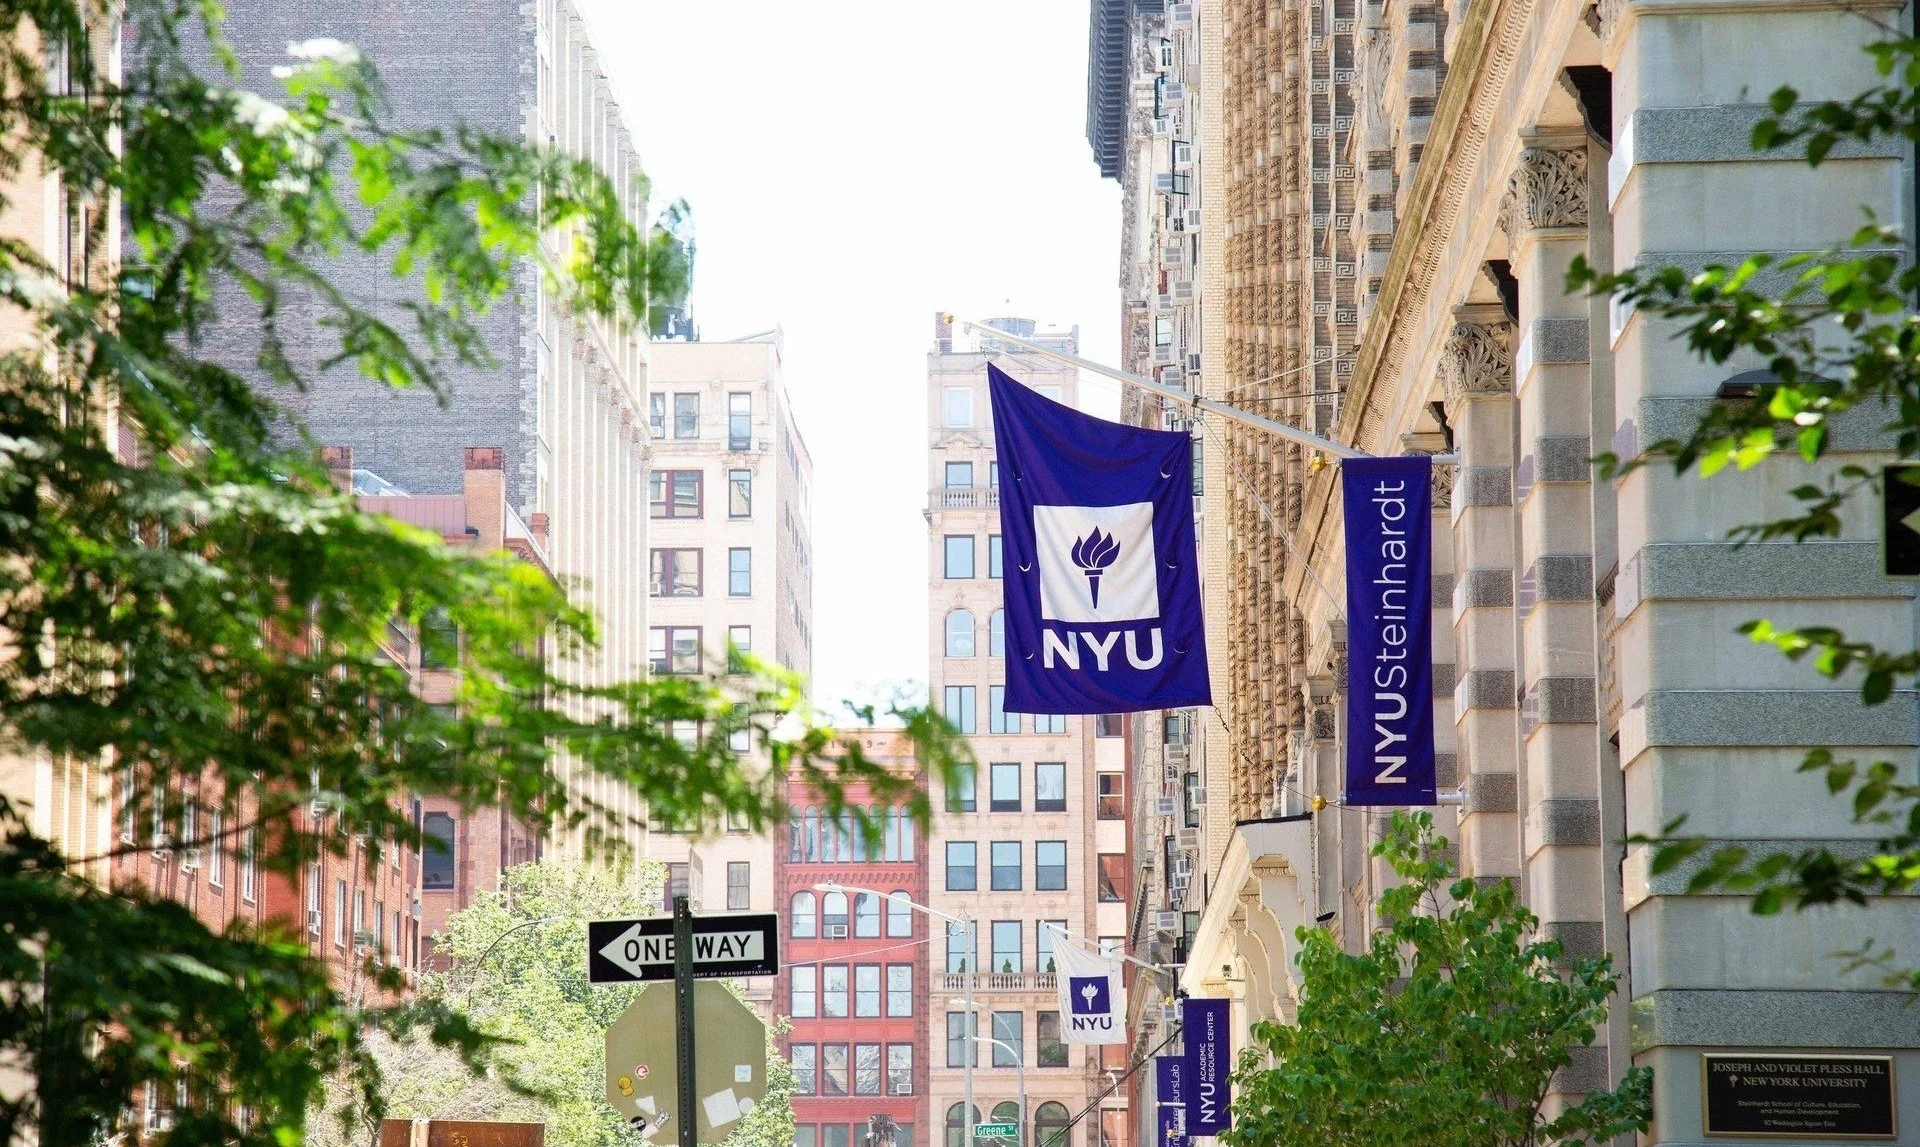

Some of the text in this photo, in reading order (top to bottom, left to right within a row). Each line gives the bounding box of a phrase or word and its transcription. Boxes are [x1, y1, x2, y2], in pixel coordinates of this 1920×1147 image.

[1372, 480, 1408, 784] NYUSteinhardt
[1042, 628, 1164, 671] NYU
[624, 935, 751, 962] ONE WAY
[1072, 1017, 1112, 1030] NYU
[1713, 1063, 1884, 1074] JOSEPH AND VIOLET PLESS HALL
[1743, 1077, 1868, 1088] NEW YORK UNIVERSITY
[1200, 1083, 1215, 1123] NYU
[977, 1126, 1006, 1135] Greene
